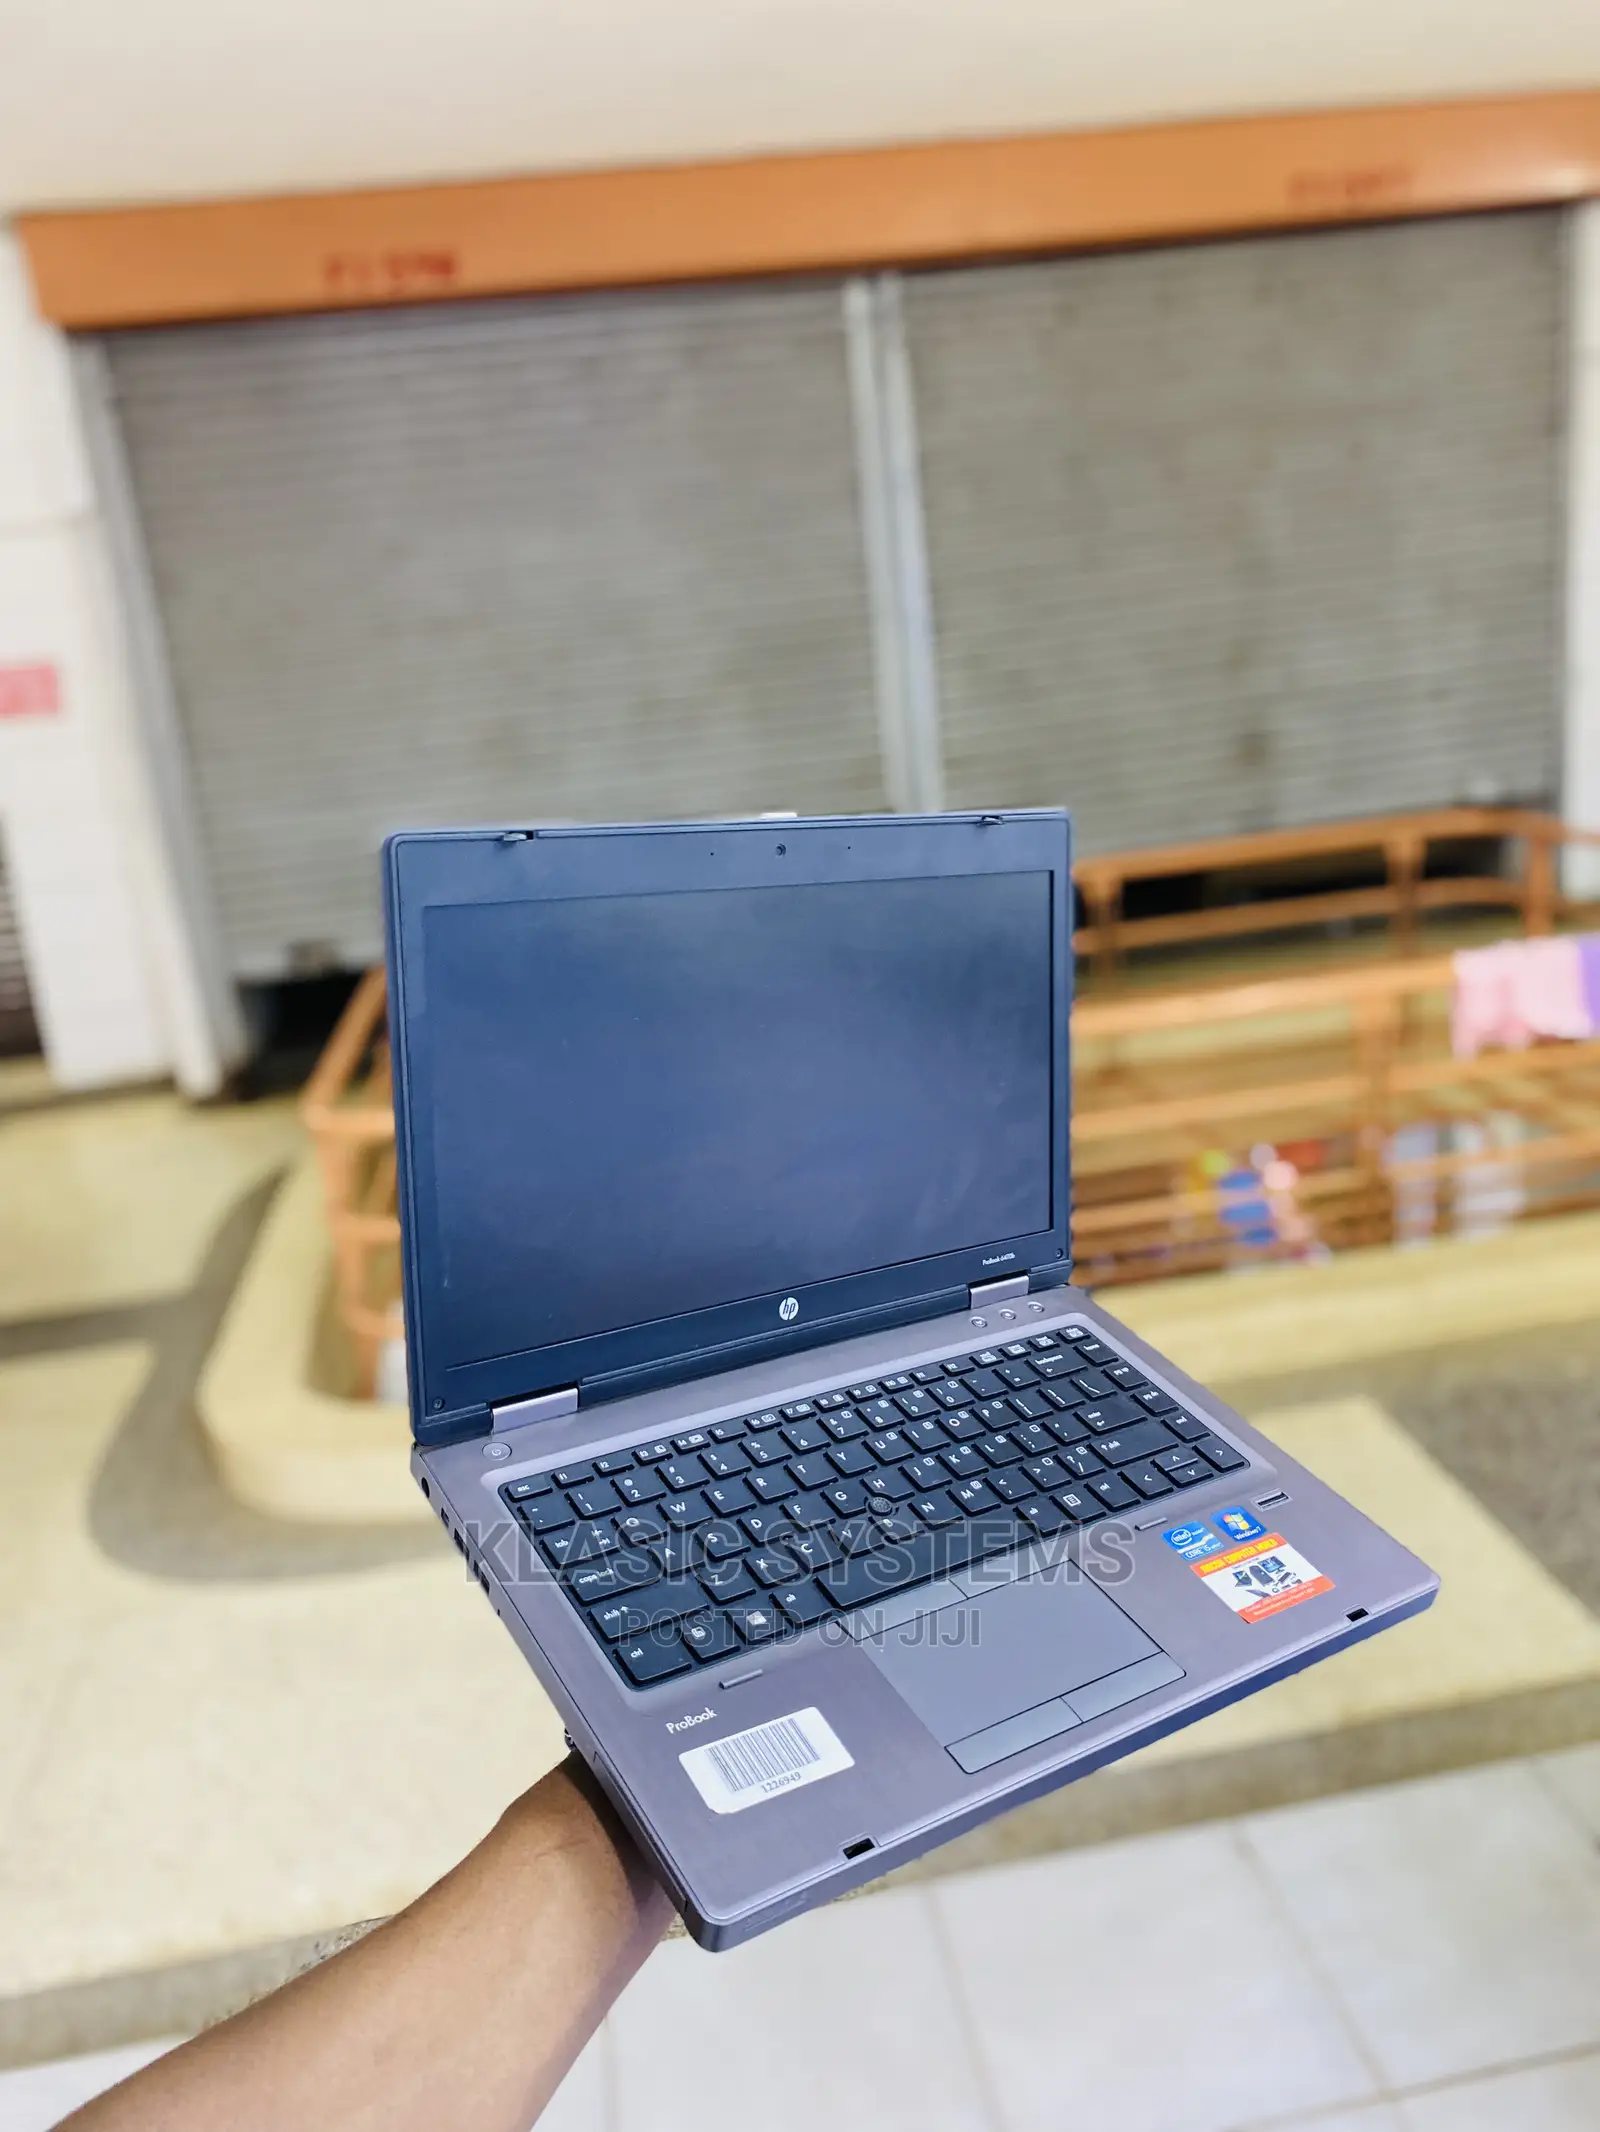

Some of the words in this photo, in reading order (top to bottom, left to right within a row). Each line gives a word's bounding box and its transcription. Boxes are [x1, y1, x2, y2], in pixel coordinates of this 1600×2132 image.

[780, 1297, 798, 1320] hp
[910, 1405, 919, 1413] 9
[982, 1409, 990, 1418] P
[948, 1418, 960, 1427] O
[836, 1426, 845, 1435] 7
[800, 1438, 809, 1446] 6
[874, 1440, 886, 1449] U
[984, 1444, 995, 1452] L
[760, 1450, 768, 1459] 5
[836, 1452, 847, 1461] Y
[948, 1454, 960, 1464] K
[720, 1462, 728, 1471] 4
[797, 1464, 807, 1474] T
[675, 1475, 685, 1484] 3
[756, 1477, 768, 1488] R
[872, 1478, 886, 1488] H
[631, 1489, 641, 1498] 2
[714, 1490, 725, 1500] E
[835, 1490, 848, 1500] G
[960, 1488, 974, 1499] M
[670, 1501, 687, 1513] W
[793, 1504, 802, 1515] F
[920, 1502, 936, 1512] N
[750, 1518, 762, 1529] D
[882, 1518, 894, 1528] B
[707, 1532, 718, 1544] S
[842, 1528, 852, 1539] V
[665, 1548, 676, 1558] A
[800, 1543, 813, 1554] C
[756, 1558, 768, 1570] X
[711, 1574, 723, 1586] Z
[630, 1647, 644, 1658] ctrl
[665, 1706, 718, 1735] ProBook
[761, 1771, 802, 1794] 1226949
